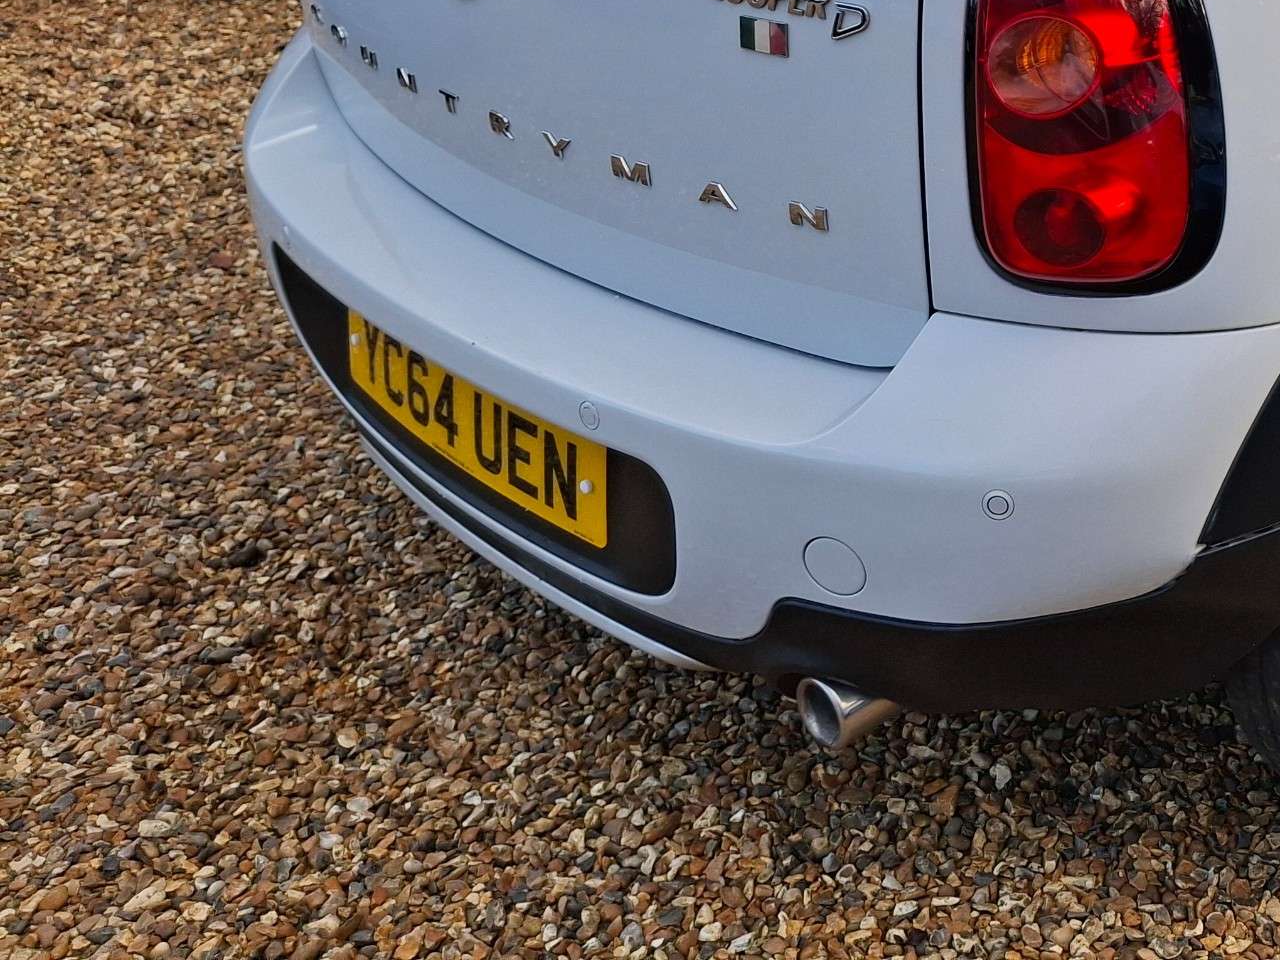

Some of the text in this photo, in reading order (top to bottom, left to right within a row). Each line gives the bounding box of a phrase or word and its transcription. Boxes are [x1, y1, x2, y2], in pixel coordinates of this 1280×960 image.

[310, 4, 829, 232] COUNTRYMAN
[831, 0, 872, 41] D
[362, 318, 578, 521] YC64 UEN
